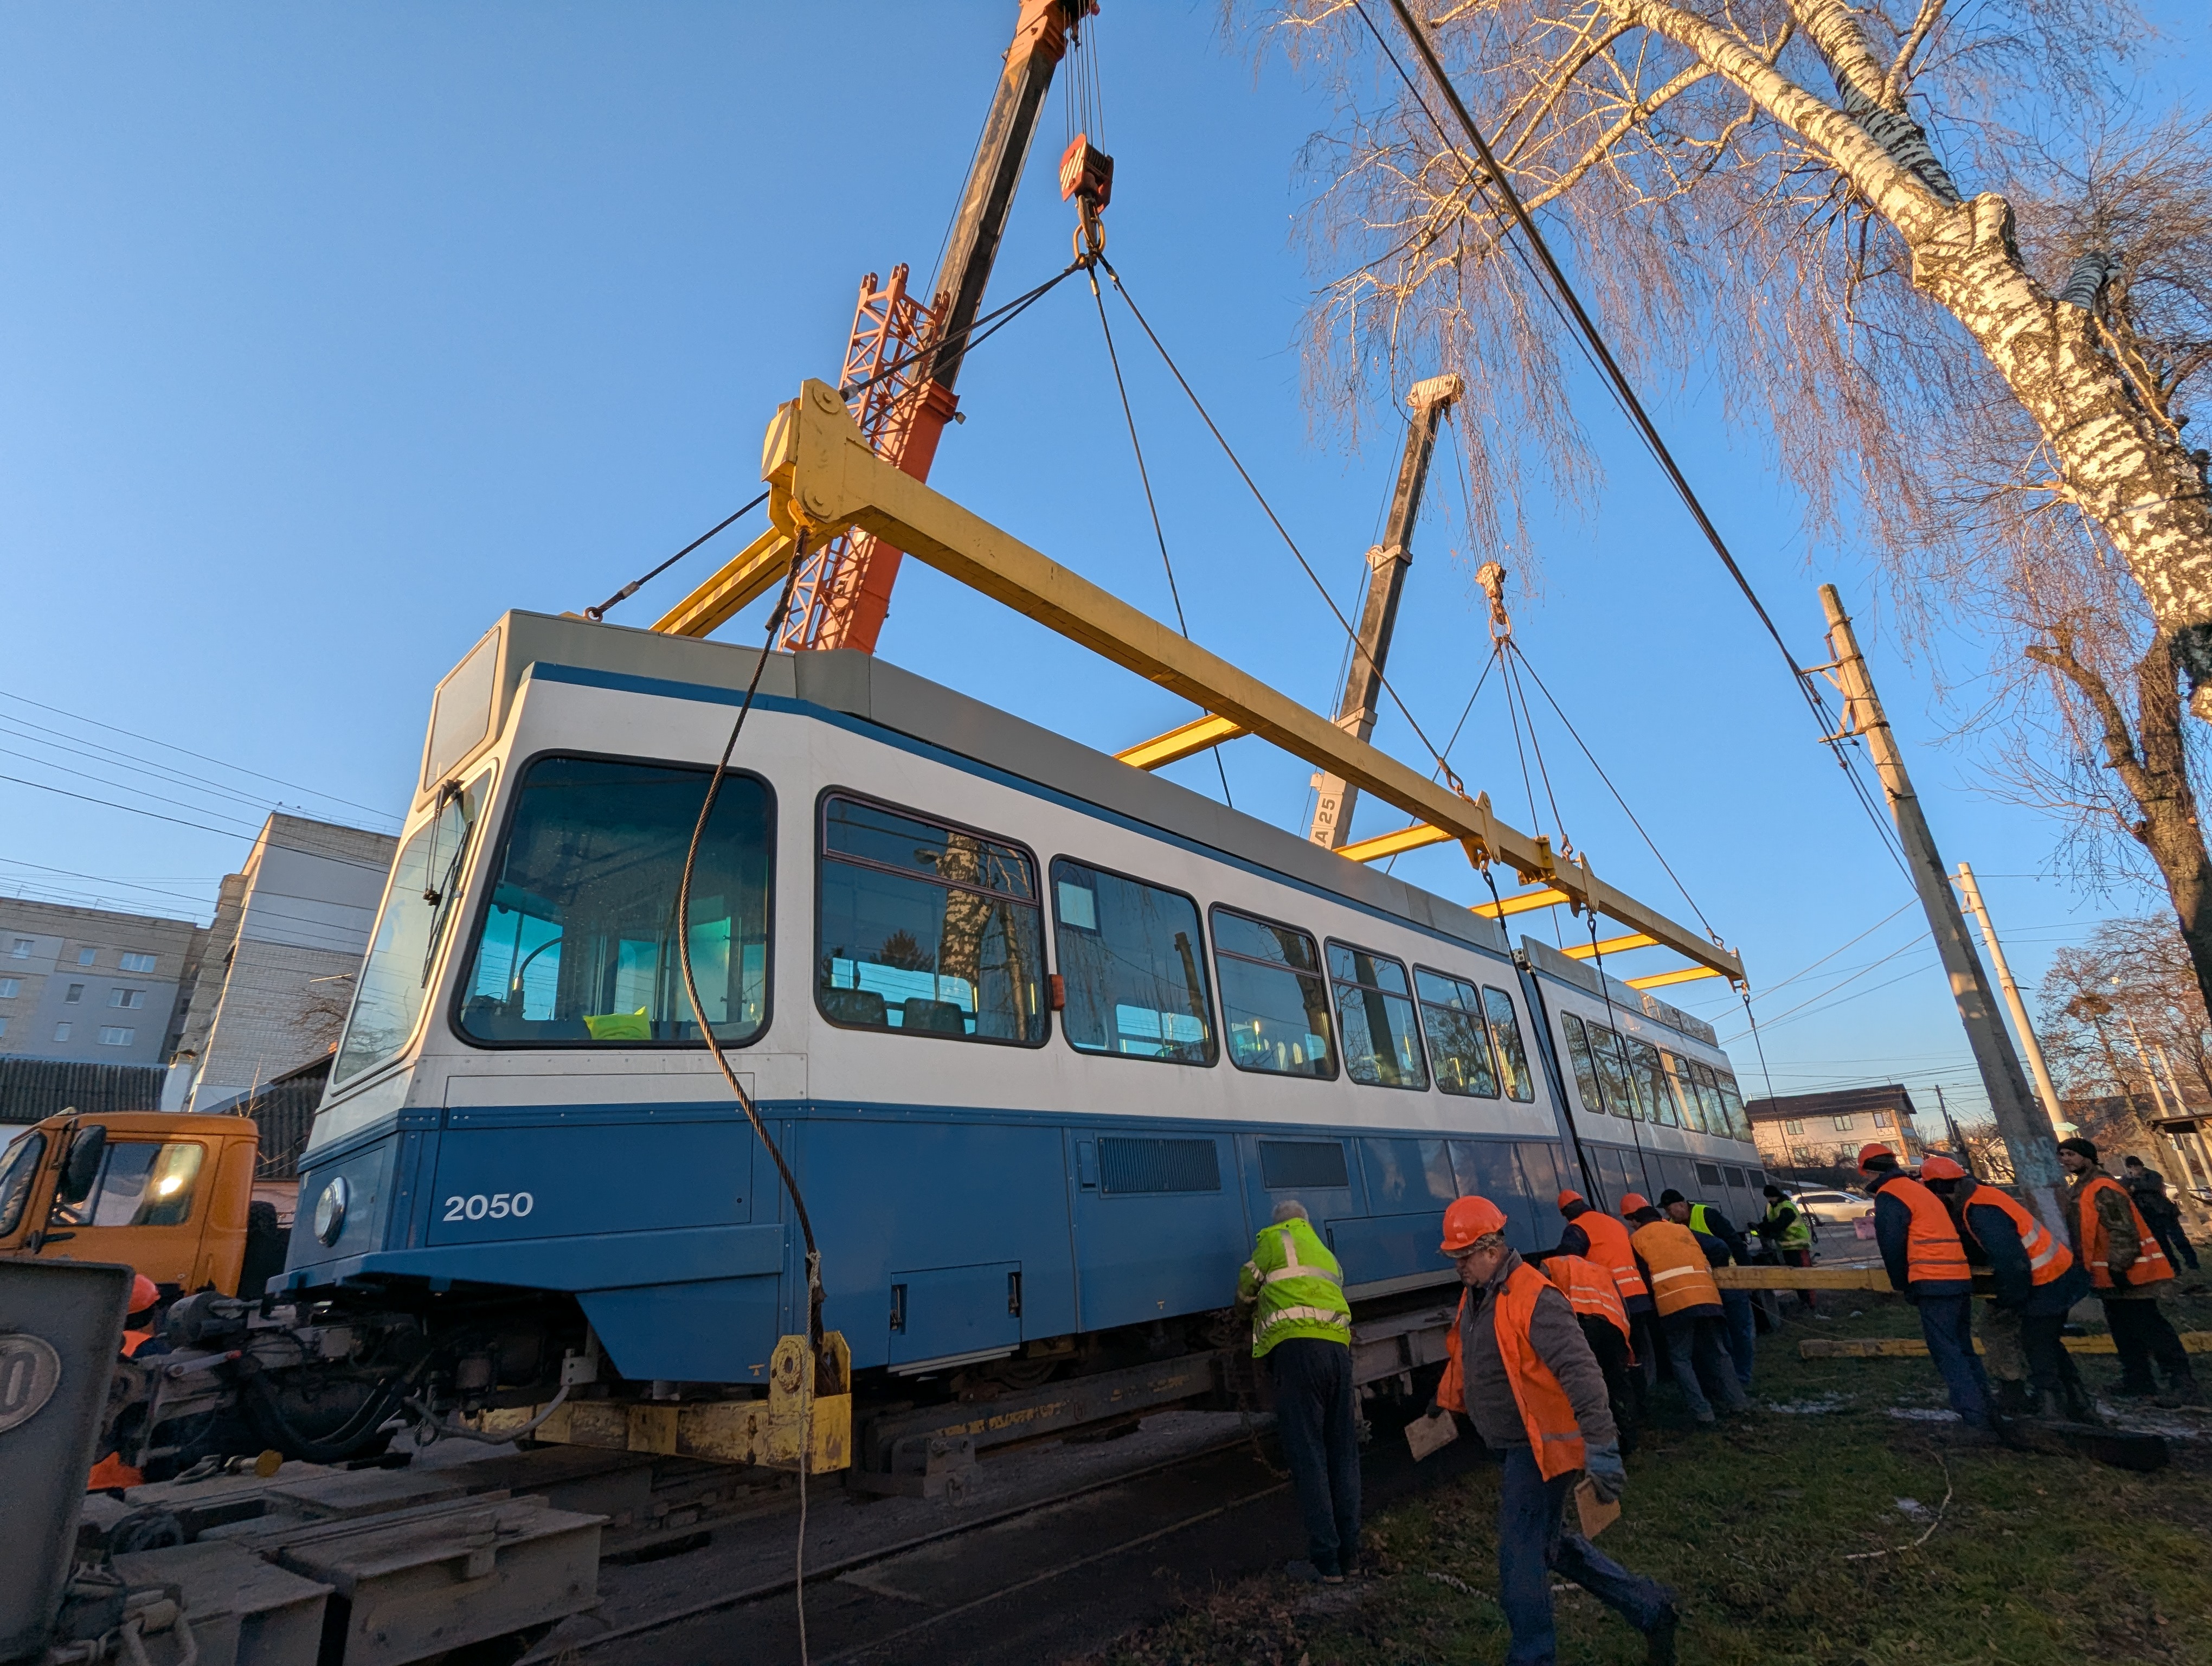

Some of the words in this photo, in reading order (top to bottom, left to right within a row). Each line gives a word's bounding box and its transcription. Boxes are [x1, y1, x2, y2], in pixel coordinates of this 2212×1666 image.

[1319, 798, 1335, 824] 25
[1314, 831, 1329, 845] A
[442, 1192, 533, 1221] 2050
